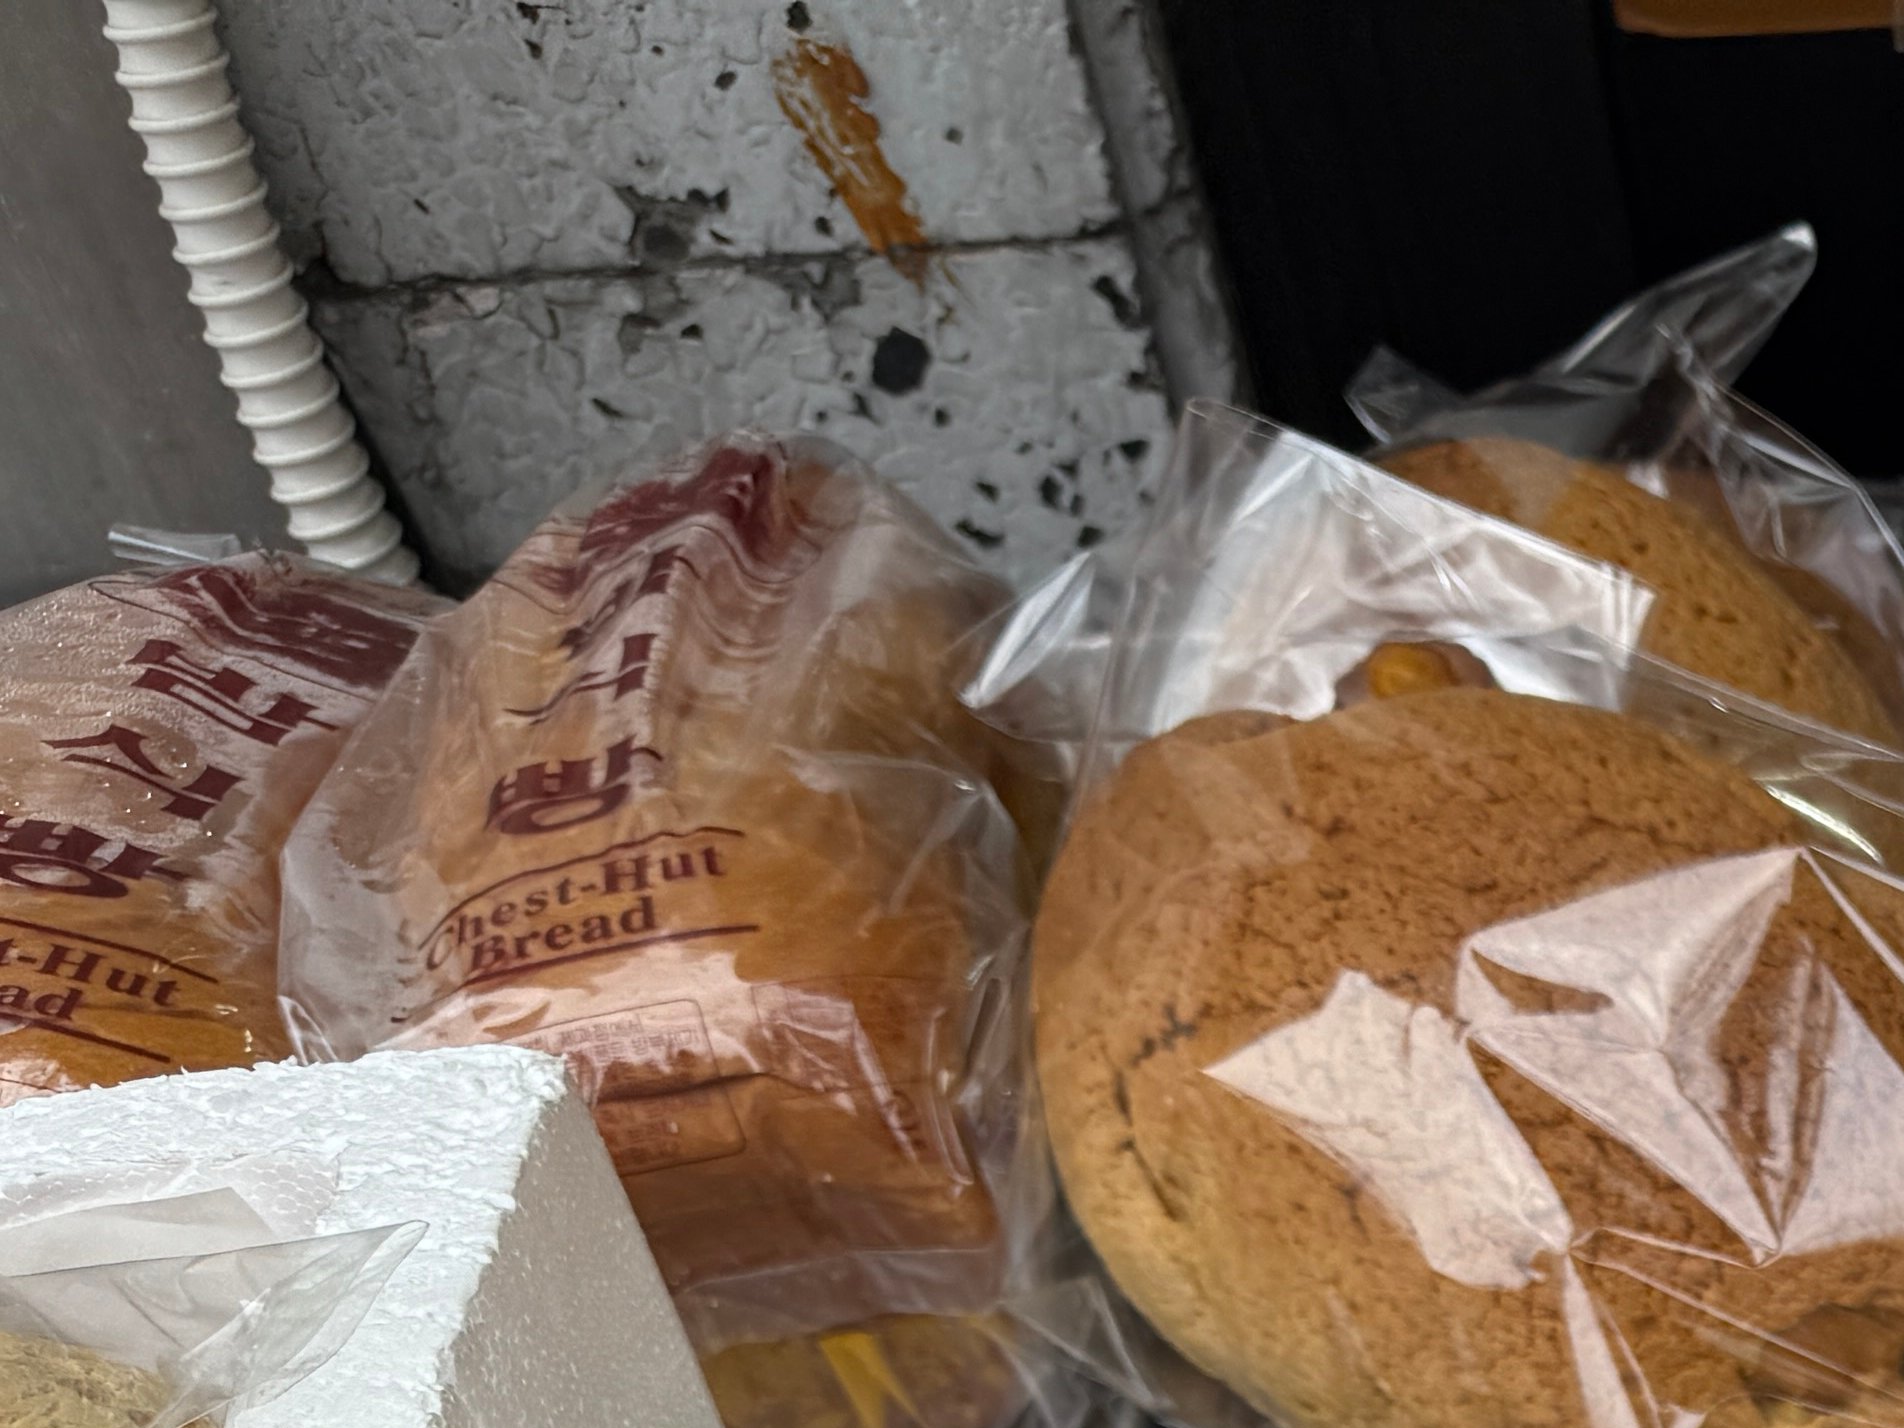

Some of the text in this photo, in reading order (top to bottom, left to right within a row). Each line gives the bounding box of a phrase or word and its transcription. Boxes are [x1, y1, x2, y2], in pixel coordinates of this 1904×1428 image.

[426, 844, 728, 971] Chest-Hut
[468, 895, 664, 974] Bread
[0, 936, 182, 1007] t-Hut
